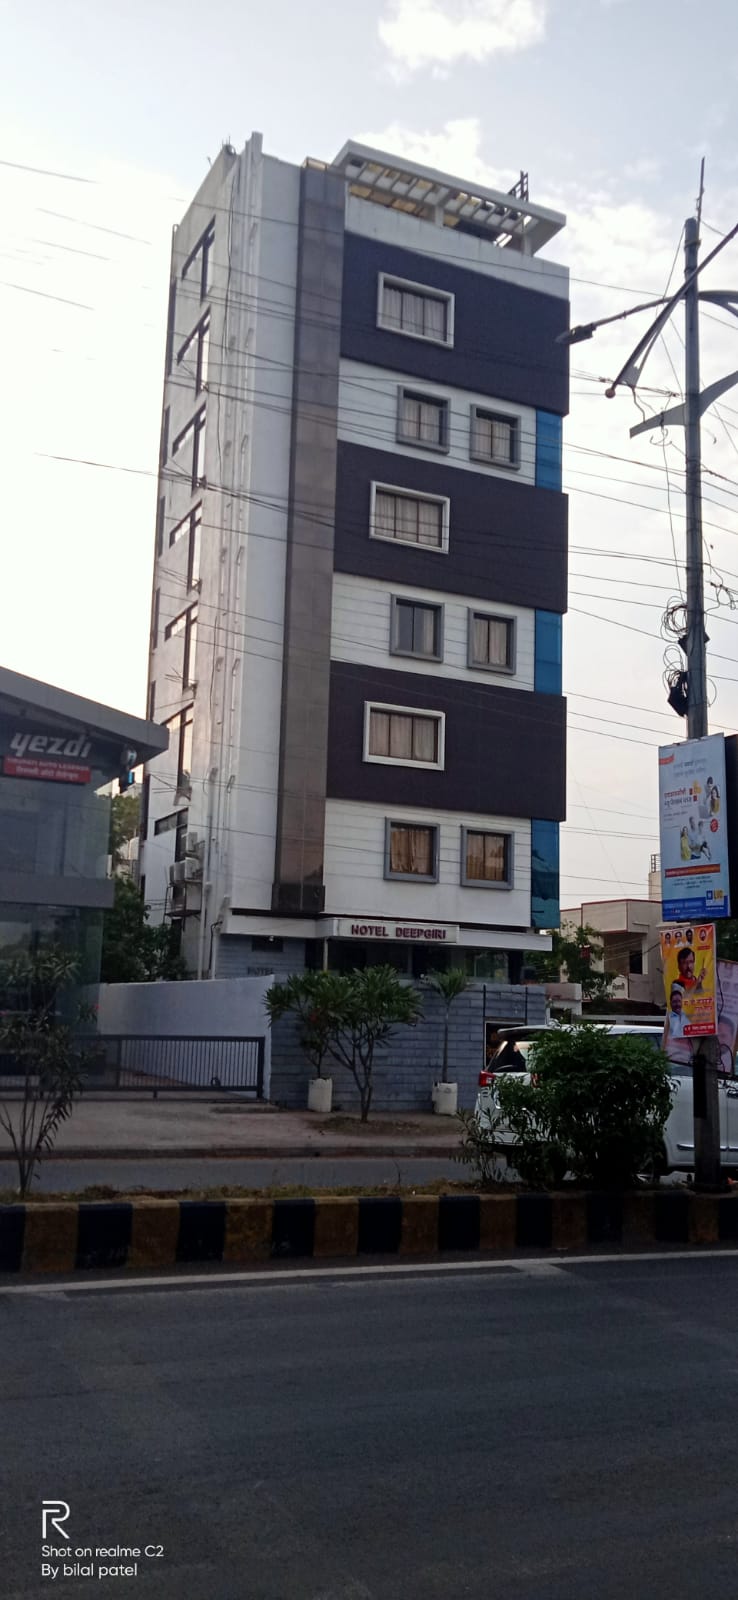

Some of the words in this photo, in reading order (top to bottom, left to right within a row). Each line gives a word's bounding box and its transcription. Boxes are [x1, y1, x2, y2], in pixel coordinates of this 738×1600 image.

[10, 732, 92, 758] yezdi
[351, 924, 389, 937] HOTEL
[395, 927, 446, 940] DEEPGIRI
